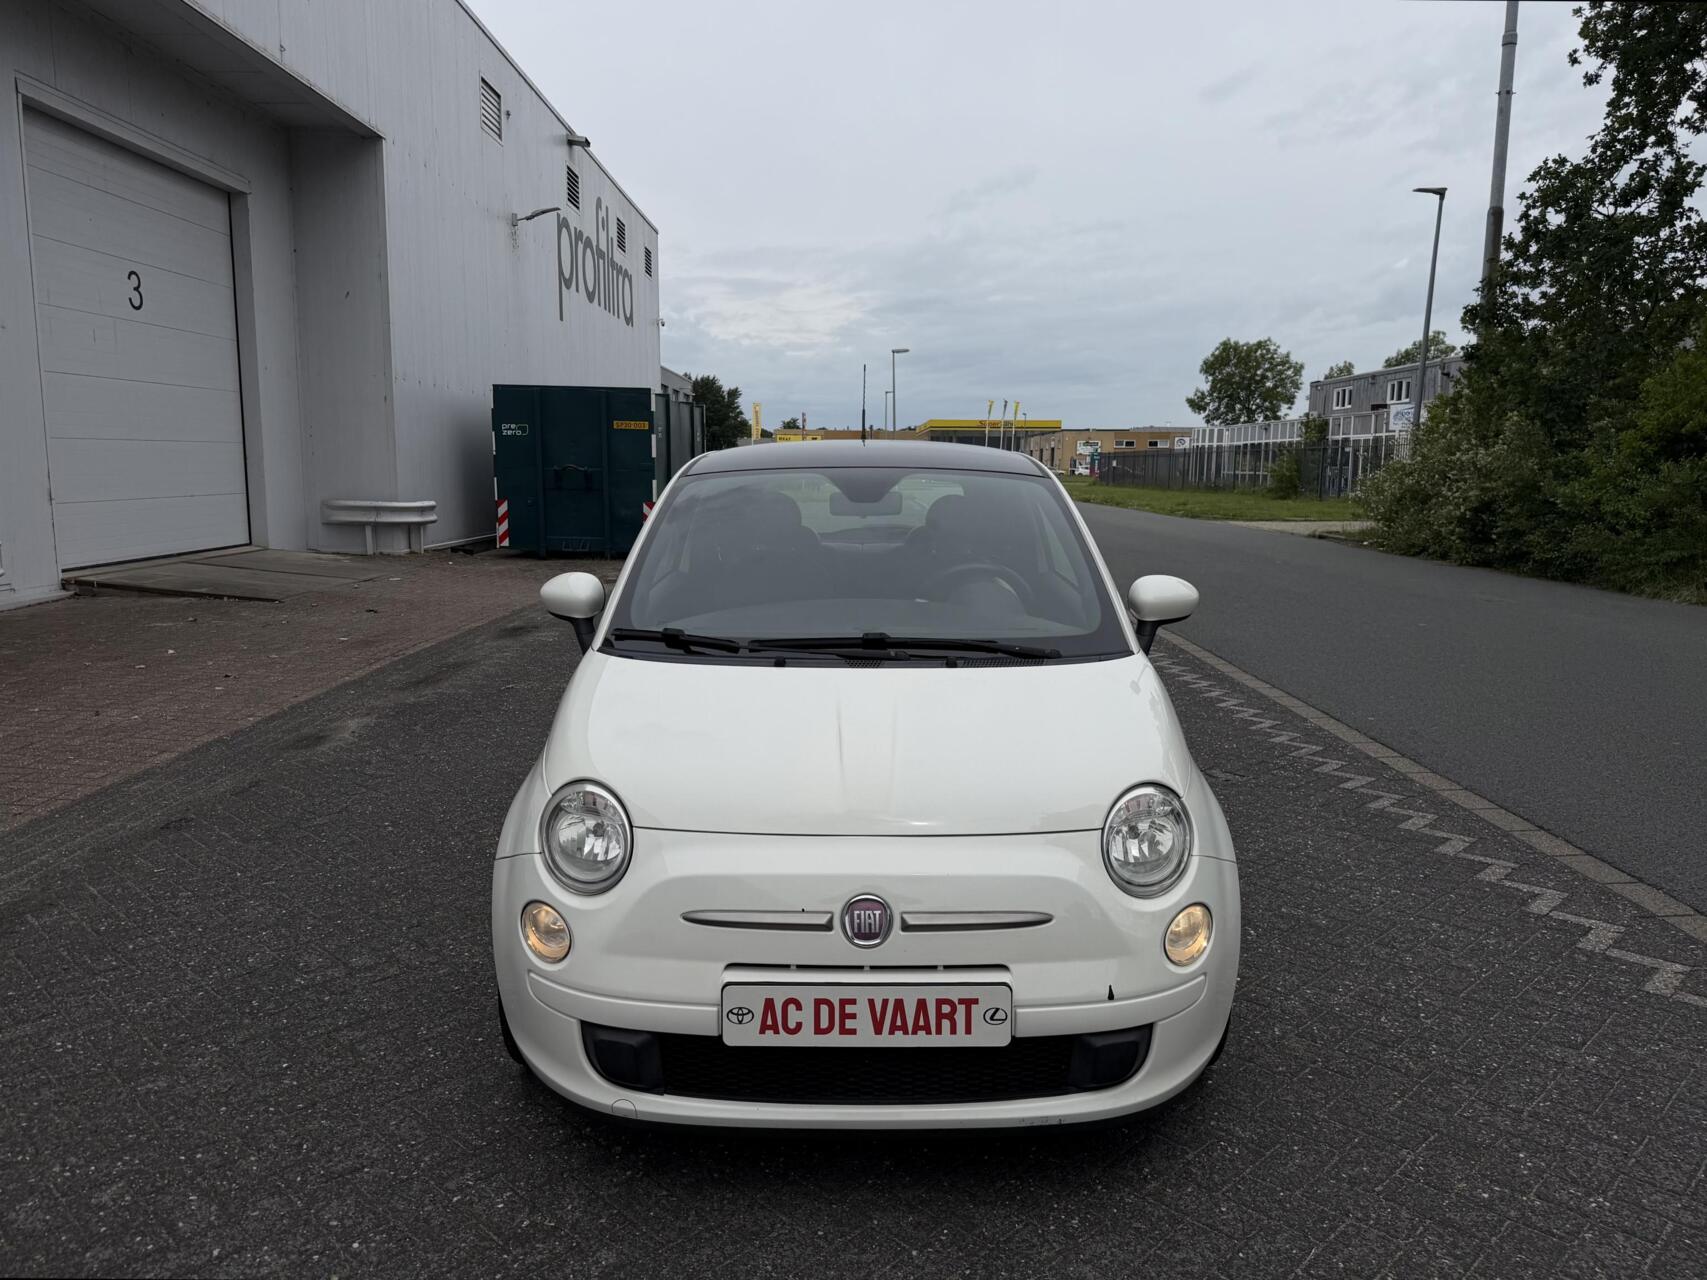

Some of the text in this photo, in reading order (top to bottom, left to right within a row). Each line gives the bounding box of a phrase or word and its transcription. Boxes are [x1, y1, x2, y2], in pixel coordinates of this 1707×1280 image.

[557, 197, 634, 328] profiltra
[127, 270, 144, 311] 3
[853, 910, 882, 934] FIAT
[758, 997, 979, 1036] AC DE VAART
